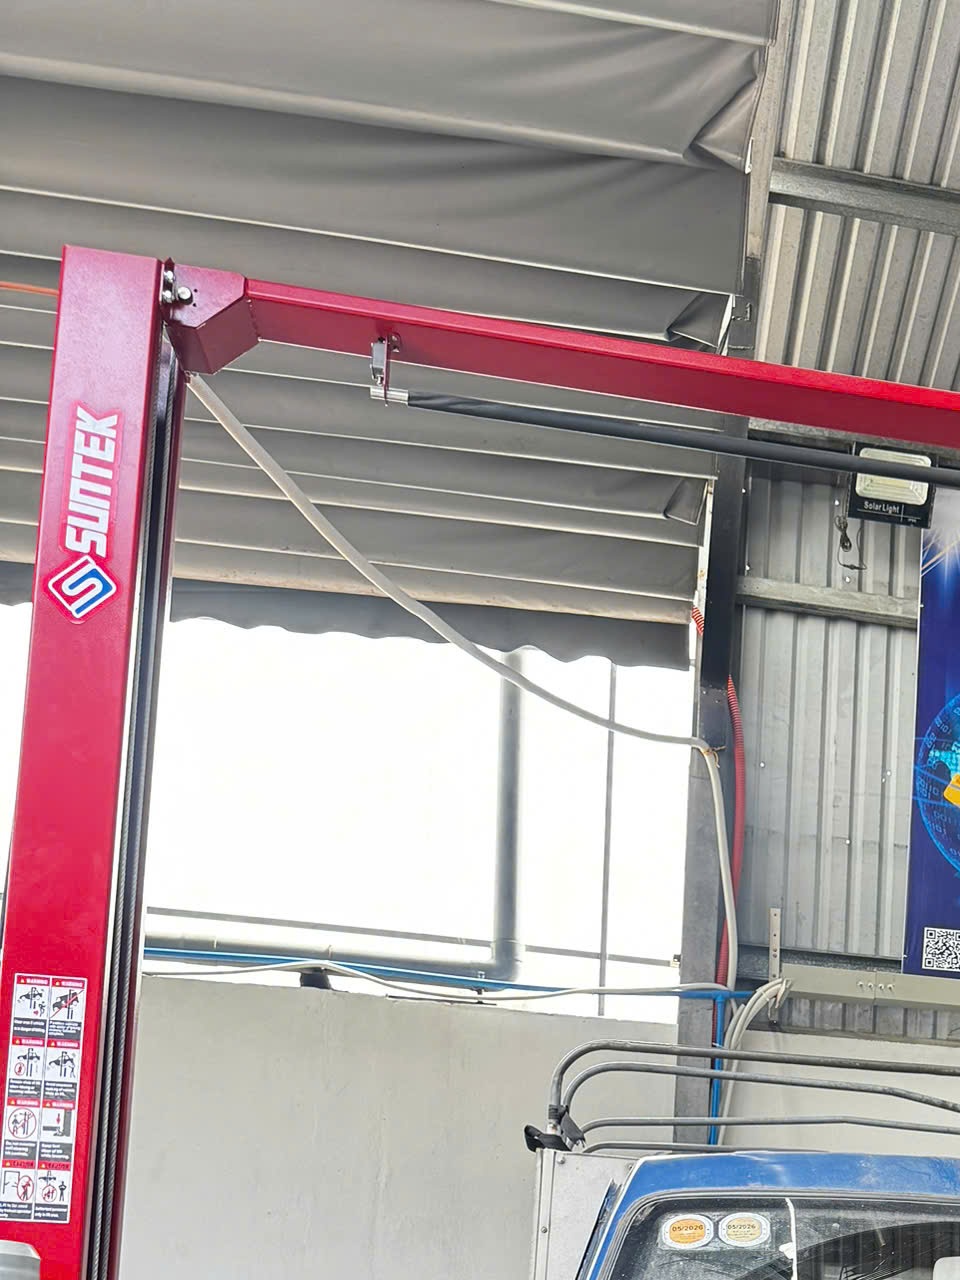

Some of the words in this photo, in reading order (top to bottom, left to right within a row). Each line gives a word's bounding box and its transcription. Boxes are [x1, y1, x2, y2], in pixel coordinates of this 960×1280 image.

[65, 405, 118, 559] SUNTEK
[864, 500, 881, 510] Solar
[882, 503, 899, 514] Light
[672, 1224, 704, 1232] 05/2026
